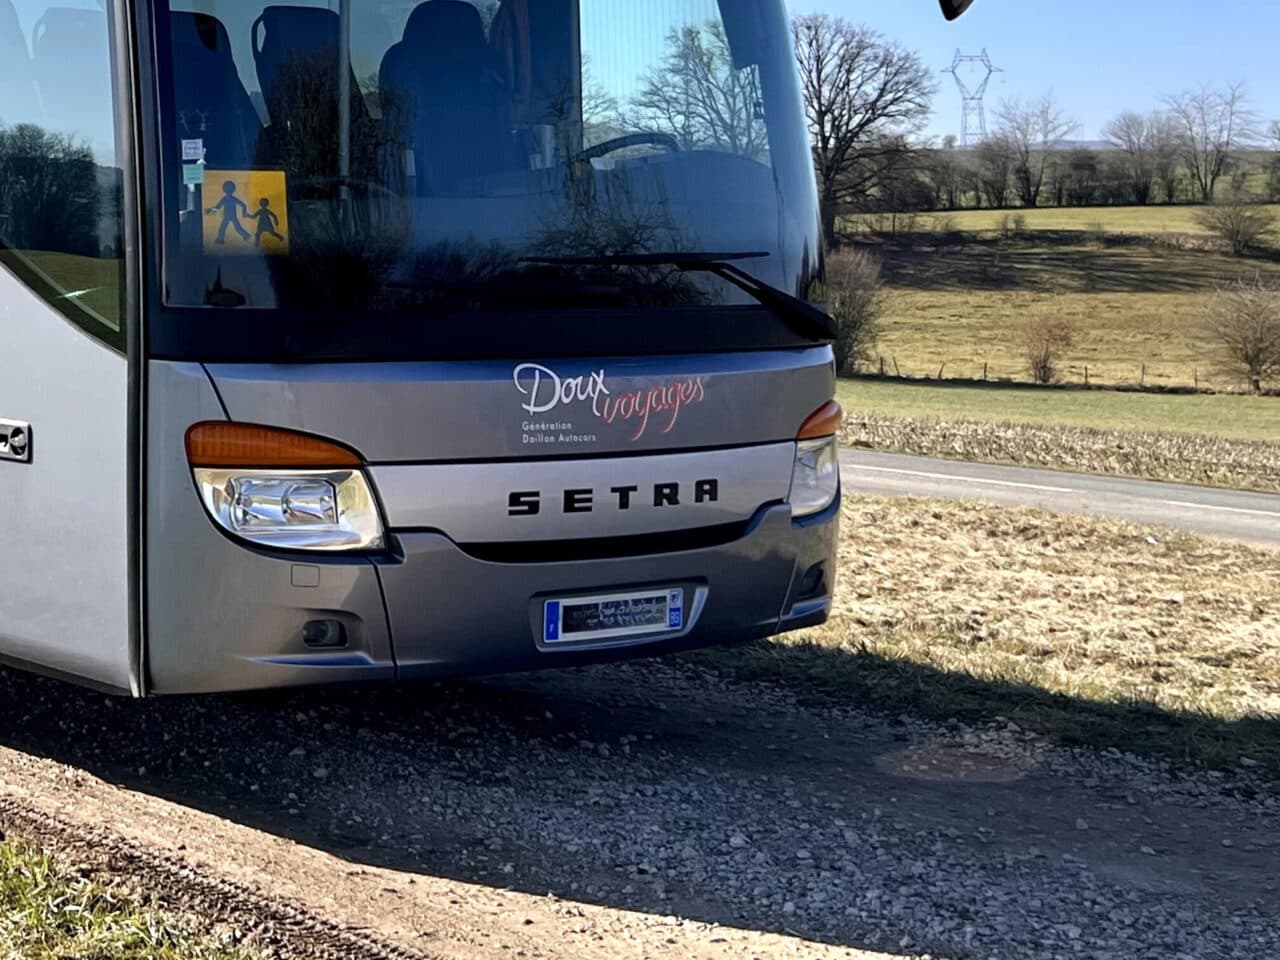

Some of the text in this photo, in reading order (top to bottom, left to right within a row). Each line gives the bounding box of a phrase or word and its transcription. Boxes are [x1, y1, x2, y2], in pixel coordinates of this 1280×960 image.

[513, 363, 610, 417] Doux
[600, 376, 704, 441] voyages
[558, 433, 597, 443] Autocars
[507, 478, 719, 517] SETRA
